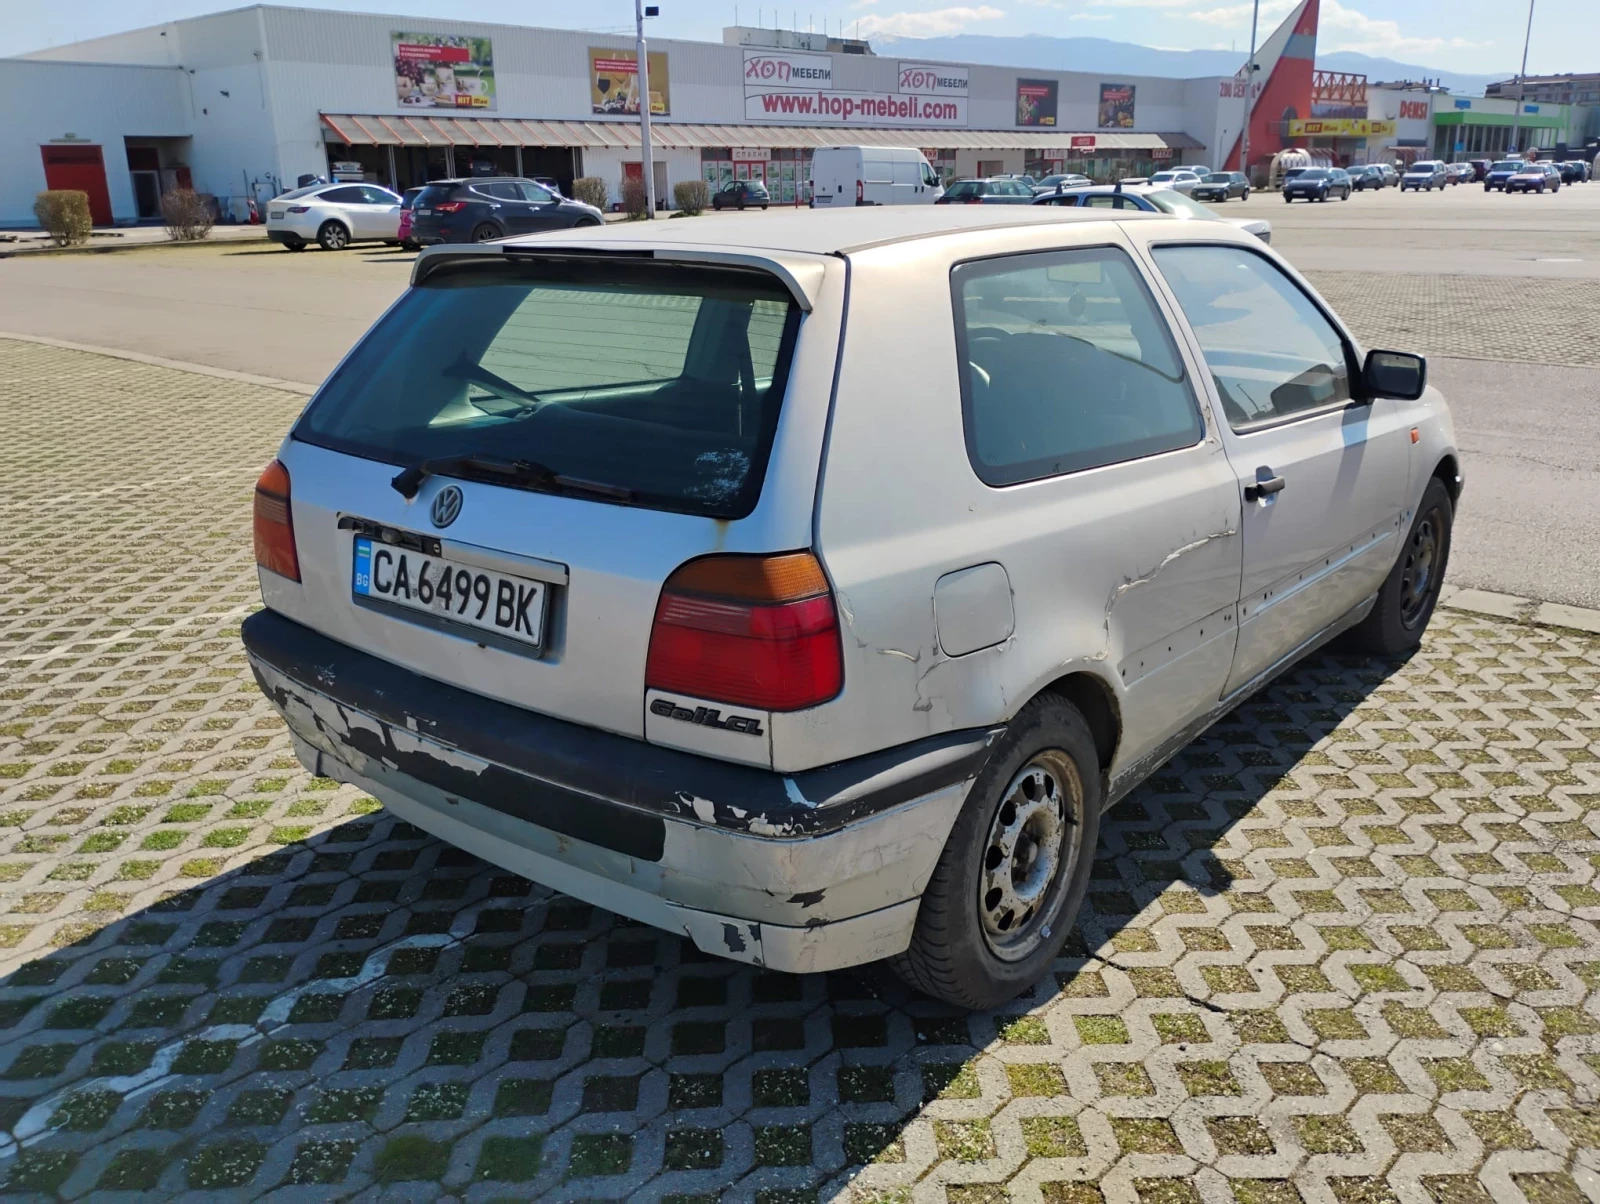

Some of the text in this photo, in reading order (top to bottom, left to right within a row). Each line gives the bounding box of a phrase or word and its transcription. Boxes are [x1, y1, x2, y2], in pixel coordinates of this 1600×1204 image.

[792, 70, 831, 81] МЕБЕЛИ
[936, 78, 968, 89] МЕБЕЛИ
[762, 91, 958, 120] www.hop-mebeli.com
[356, 572, 369, 587] BG
[418, 560, 491, 620] 6499
